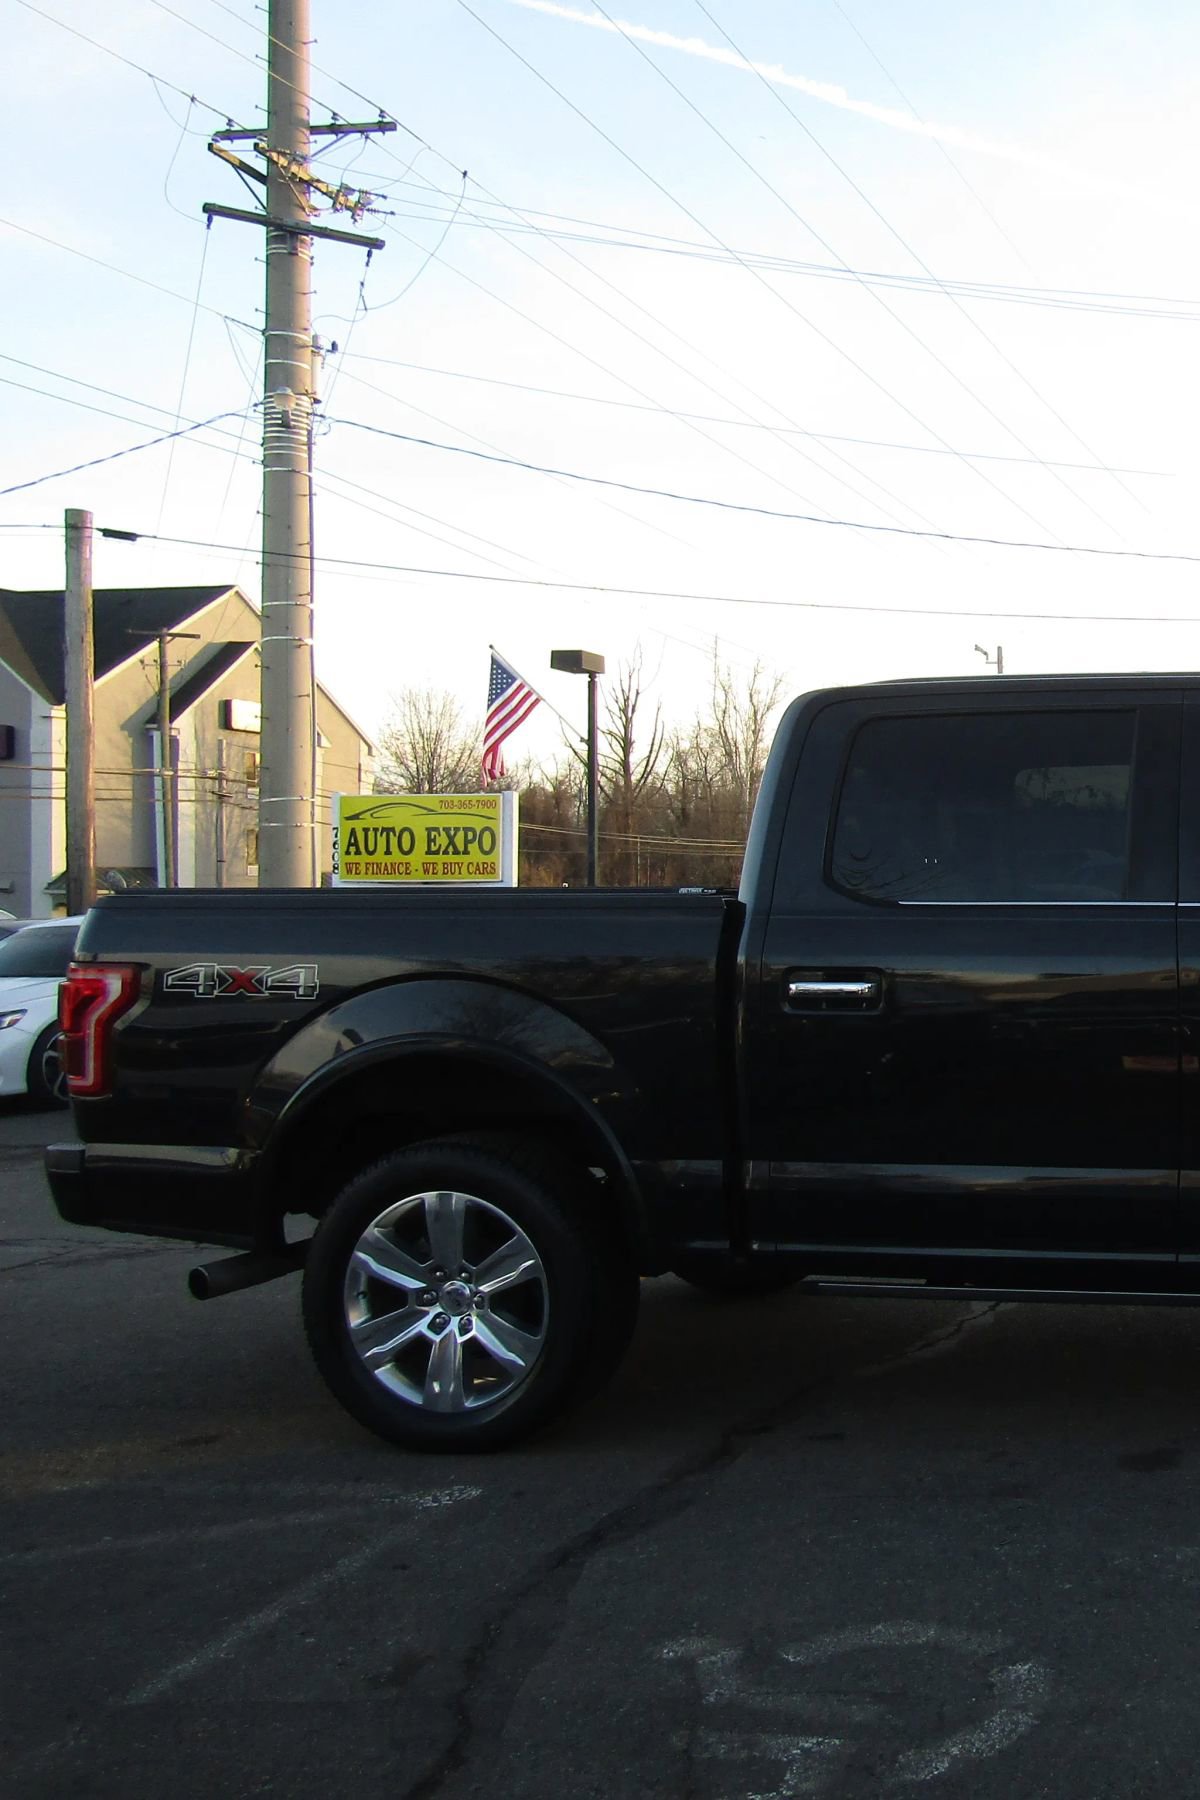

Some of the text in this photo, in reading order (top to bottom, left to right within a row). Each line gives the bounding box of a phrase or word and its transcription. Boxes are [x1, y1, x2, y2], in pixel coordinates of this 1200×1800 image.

[439, 800, 496, 809] 703-365-7900
[345, 826, 496, 856] AUTO EXPO
[345, 862, 361, 875] WE
[365, 862, 411, 875] FINANCE
[422, 862, 438, 875] WE
[442, 862, 463, 875] BUY
[467, 862, 496, 875] CARS
